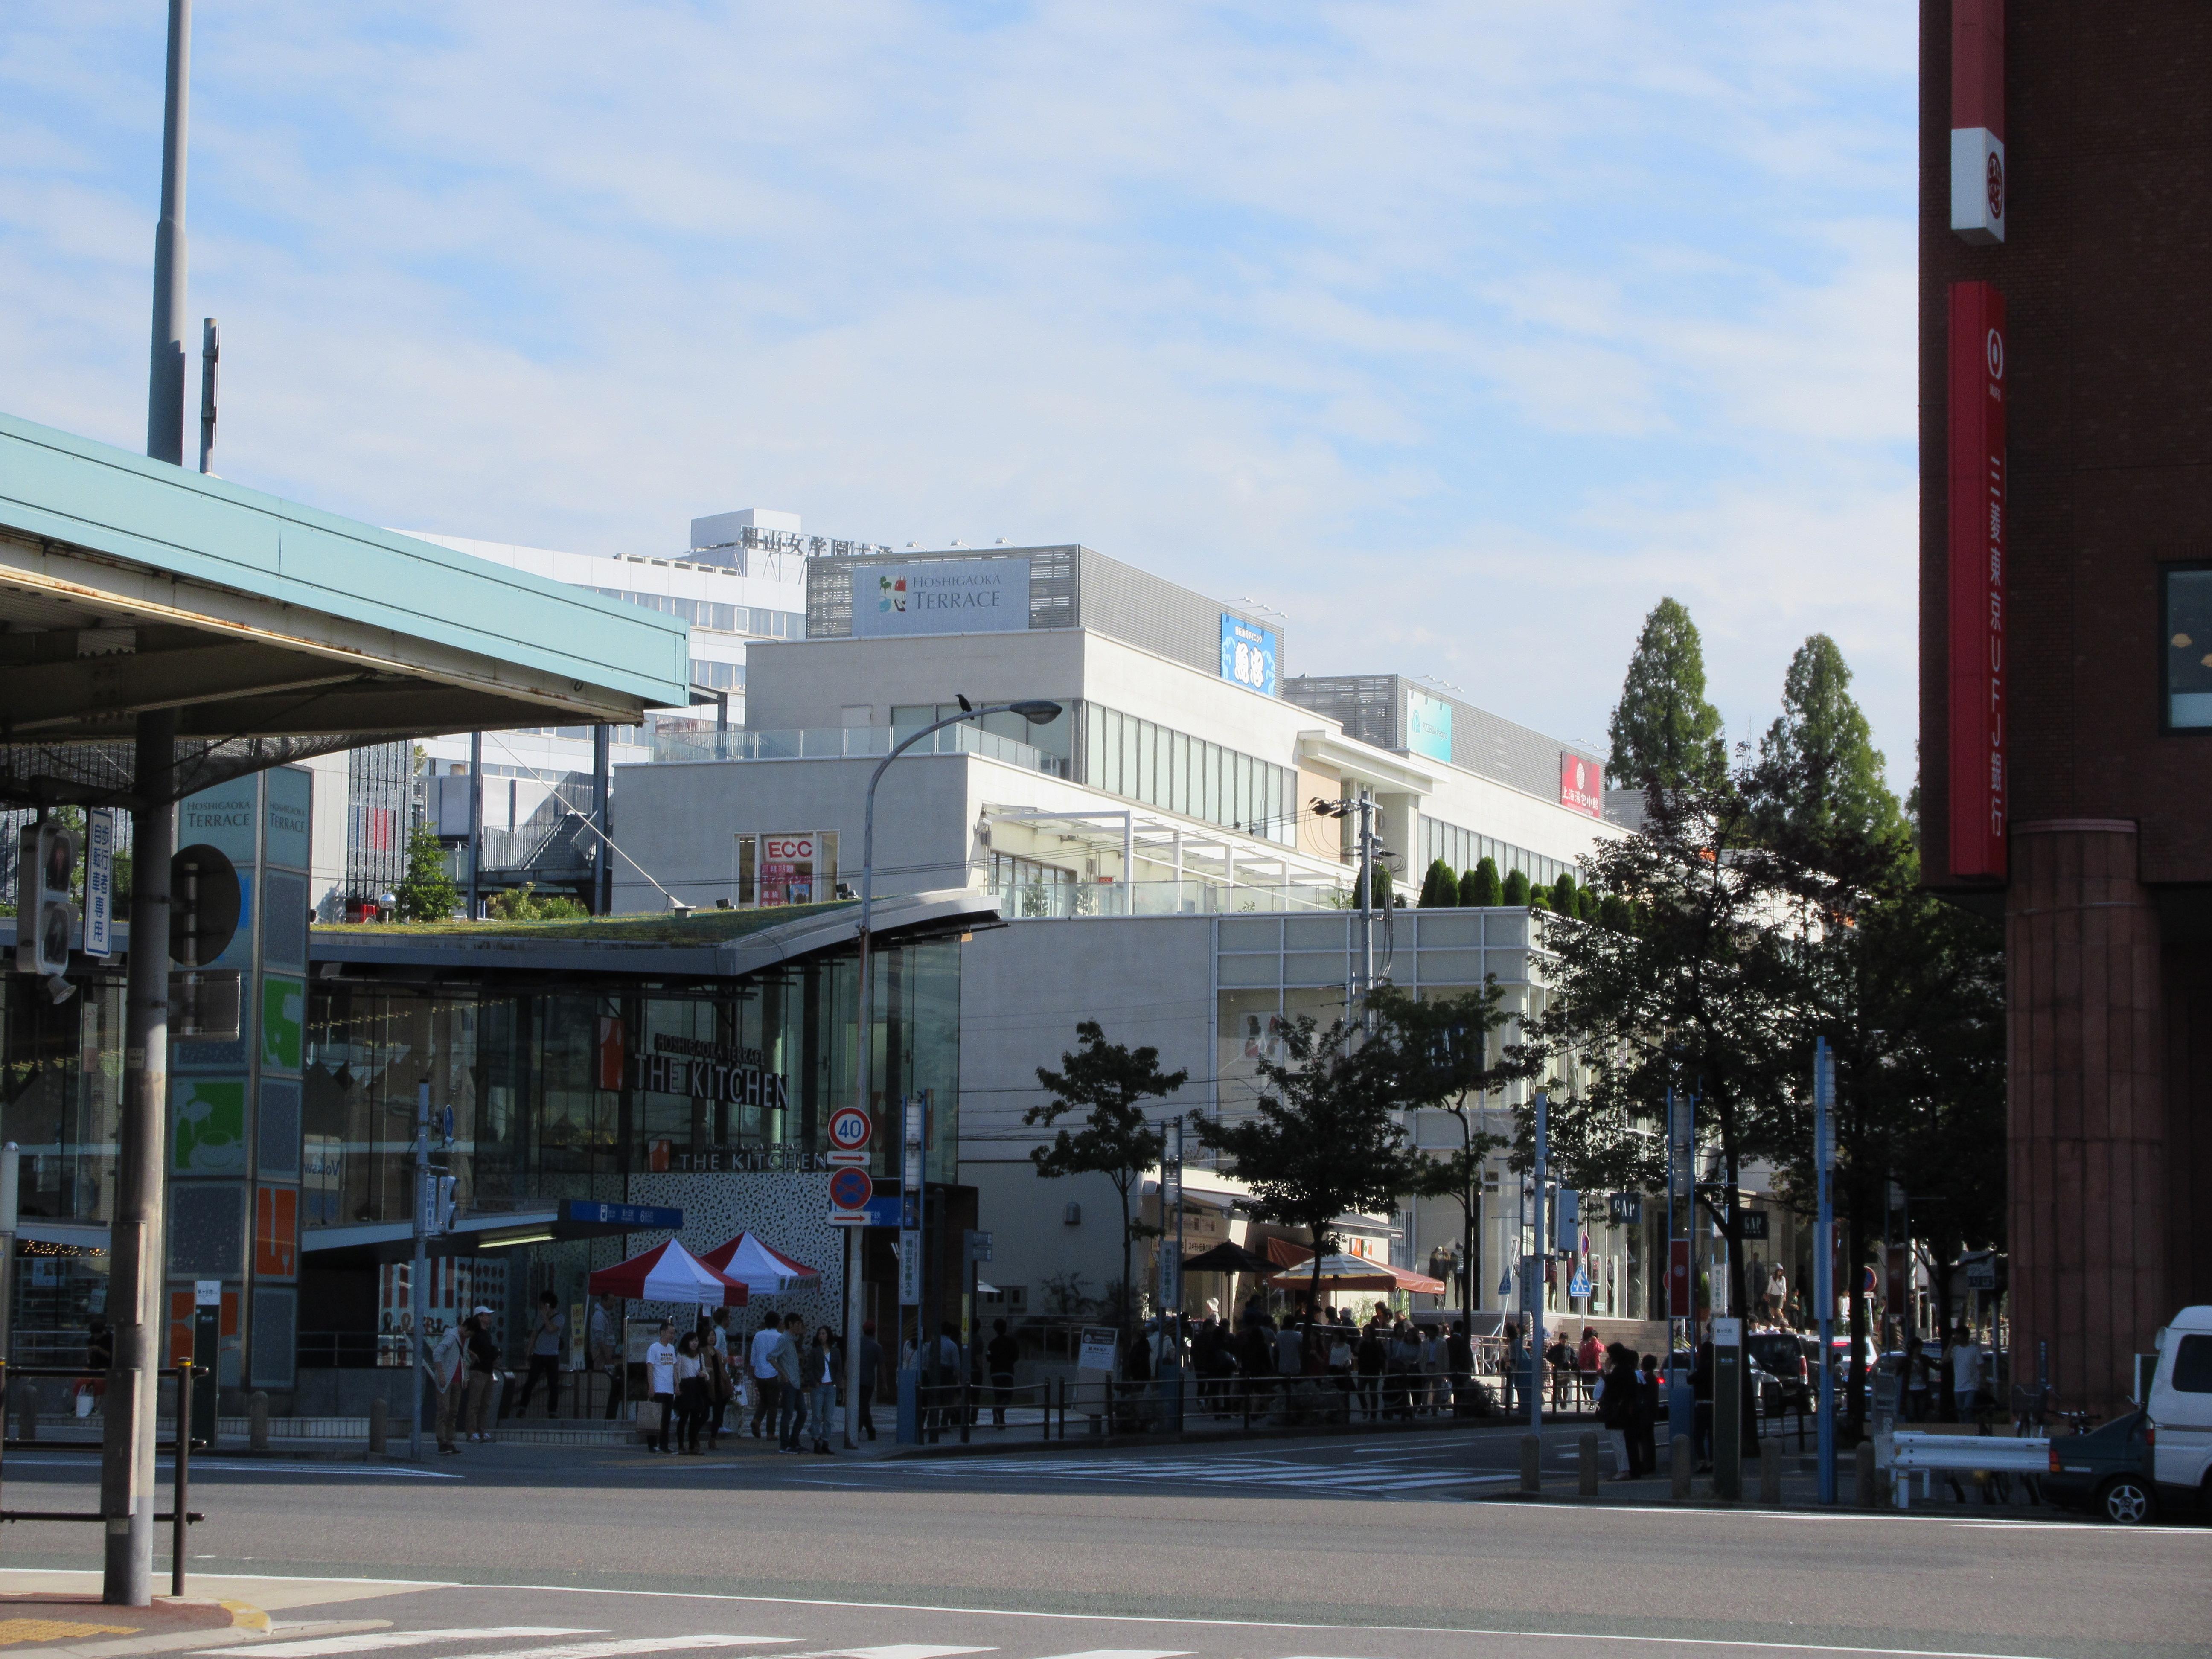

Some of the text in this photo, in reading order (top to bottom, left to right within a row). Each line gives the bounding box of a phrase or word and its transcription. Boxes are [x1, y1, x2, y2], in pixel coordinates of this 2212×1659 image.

[912, 573, 1001, 588] HOSHIGAOKA
[913, 591, 1001, 610] TERRACE
[187, 800, 250, 810] HOSHIGAOKA
[1562, 786, 1598, 810] 上海湯包小館
[269, 800, 305, 816] HOSHIGAOKA
[187, 812, 250, 827] TERRACE
[269, 812, 305, 833] TERRACE
[768, 841, 813, 858] ECC
[657, 1034, 765, 1066] HOSHIGAOKA TERRACE
[634, 1053, 789, 1111] THE KITCHEN
[838, 1119, 861, 1138] 40
[679, 1152, 827, 1170] THE KITCHEN
[1615, 1199, 1635, 1217] GAP
[1745, 1217, 1761, 1230] GAP
